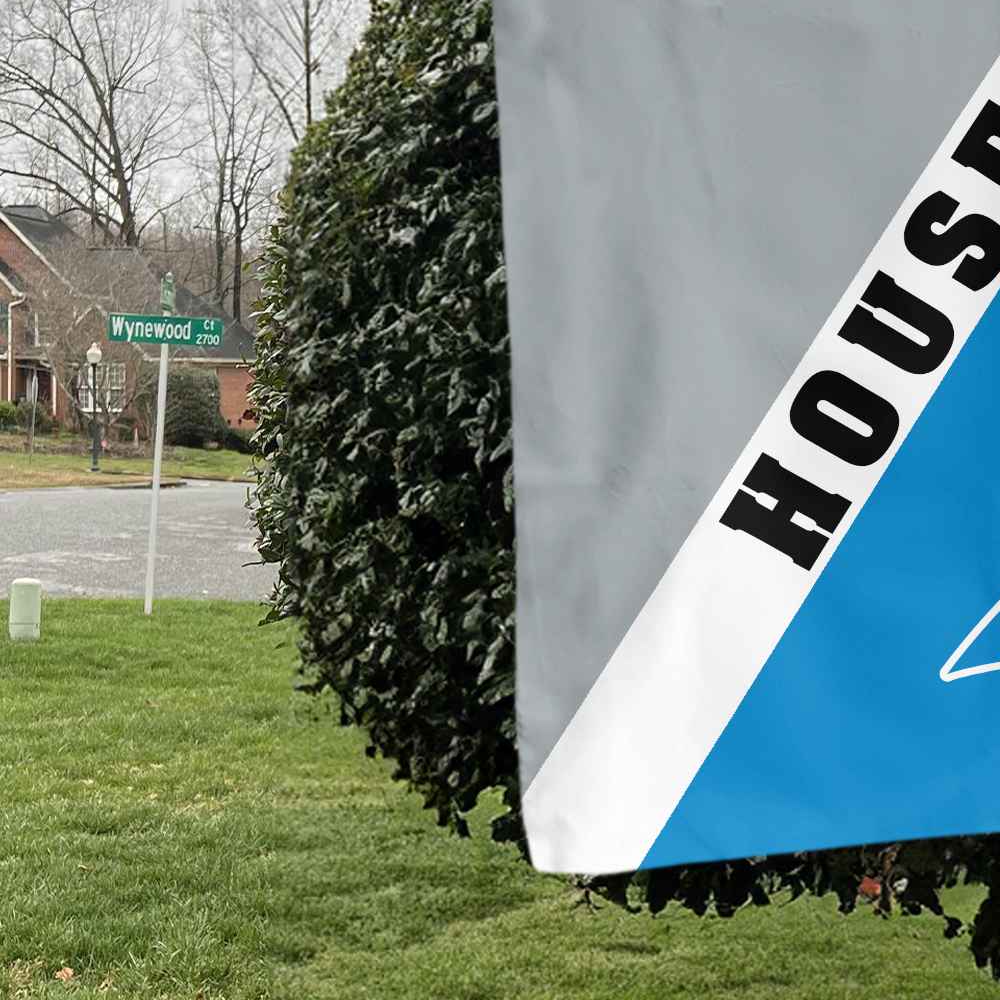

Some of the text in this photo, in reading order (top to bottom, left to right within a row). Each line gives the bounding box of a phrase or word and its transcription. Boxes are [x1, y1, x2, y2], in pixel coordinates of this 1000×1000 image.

[112, 316, 215, 342] Wynewood Ct
[196, 333, 220, 345] 2700
